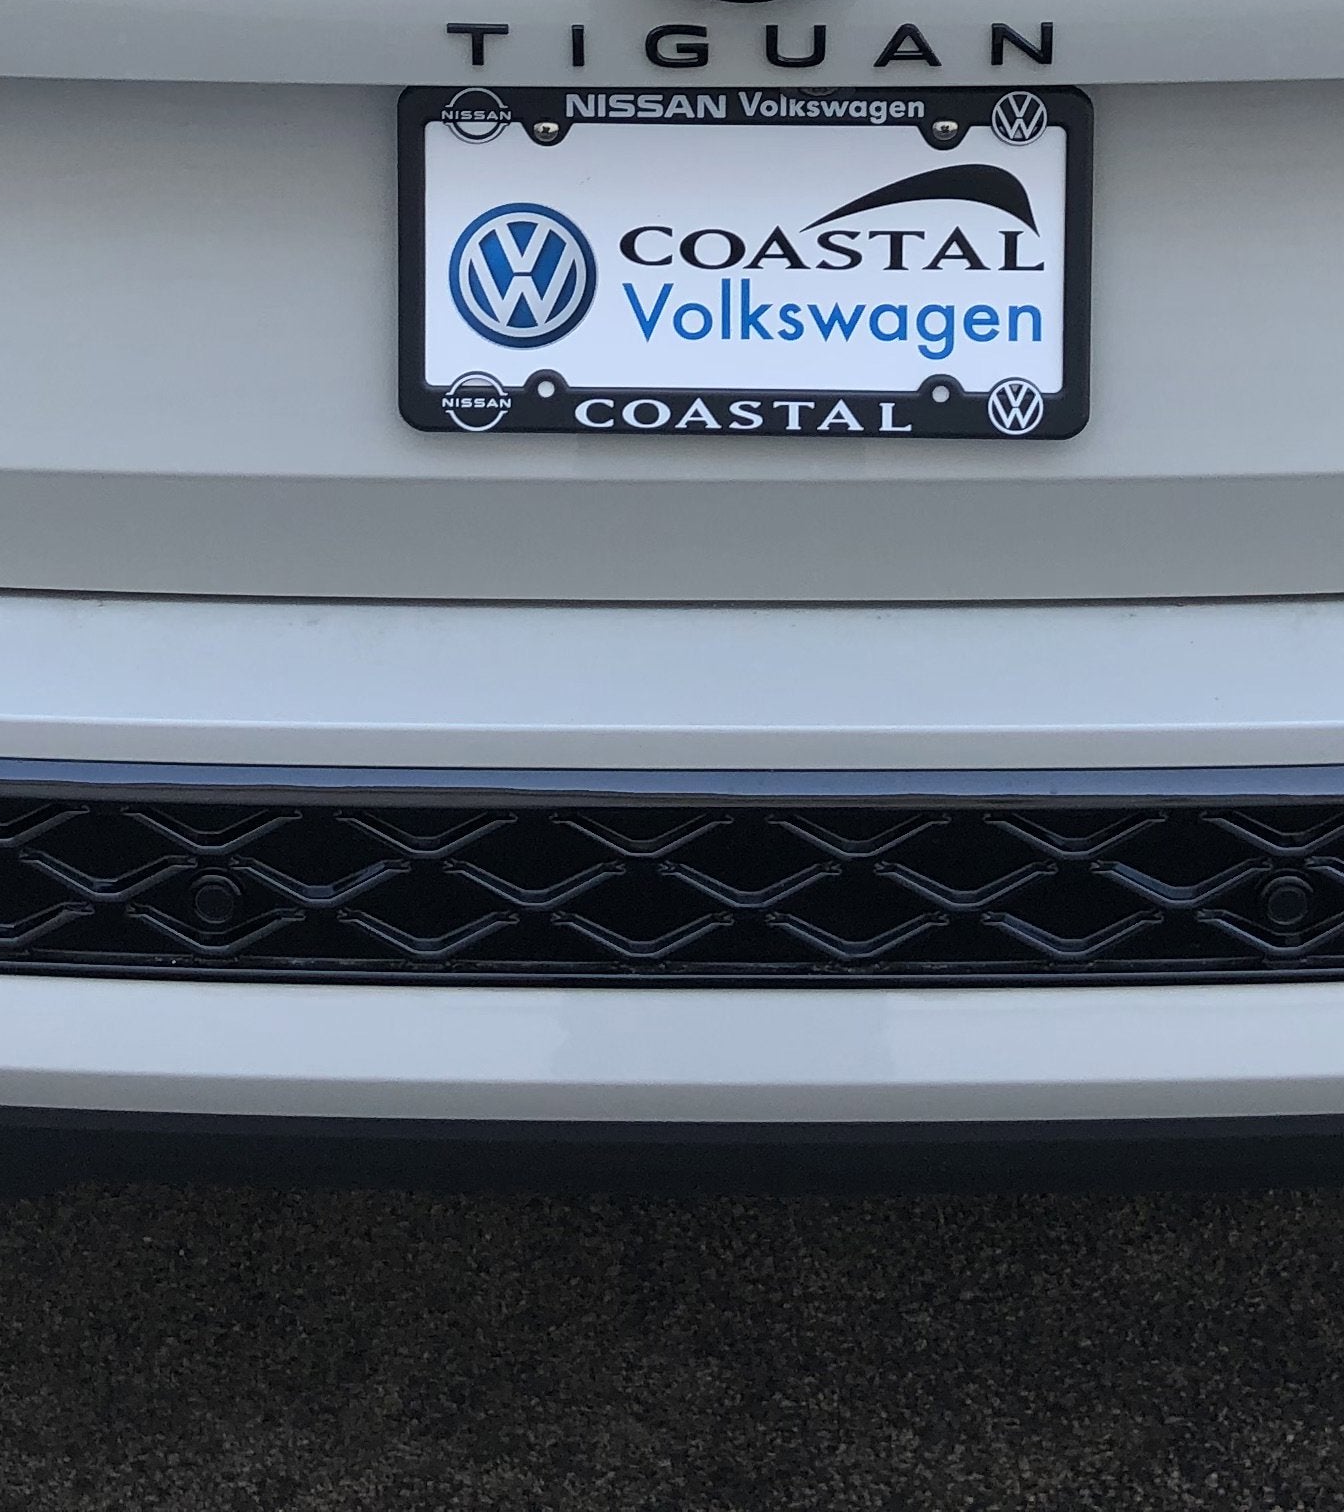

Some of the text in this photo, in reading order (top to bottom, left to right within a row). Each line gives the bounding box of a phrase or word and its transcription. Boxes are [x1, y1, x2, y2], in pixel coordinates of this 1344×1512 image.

[446, 22, 1054, 69] TIGUAN
[441, 110, 512, 121] NISSAN
[565, 91, 925, 124] NISSAN Volkswagen
[992, 91, 1048, 146] VW
[619, 226, 1045, 272] COASTAL
[454, 210, 593, 343] VW
[622, 278, 1045, 361] Volkswagen
[442, 397, 512, 410] NISSAN
[574, 397, 913, 432] COASTAL
[988, 377, 1044, 435] VW
